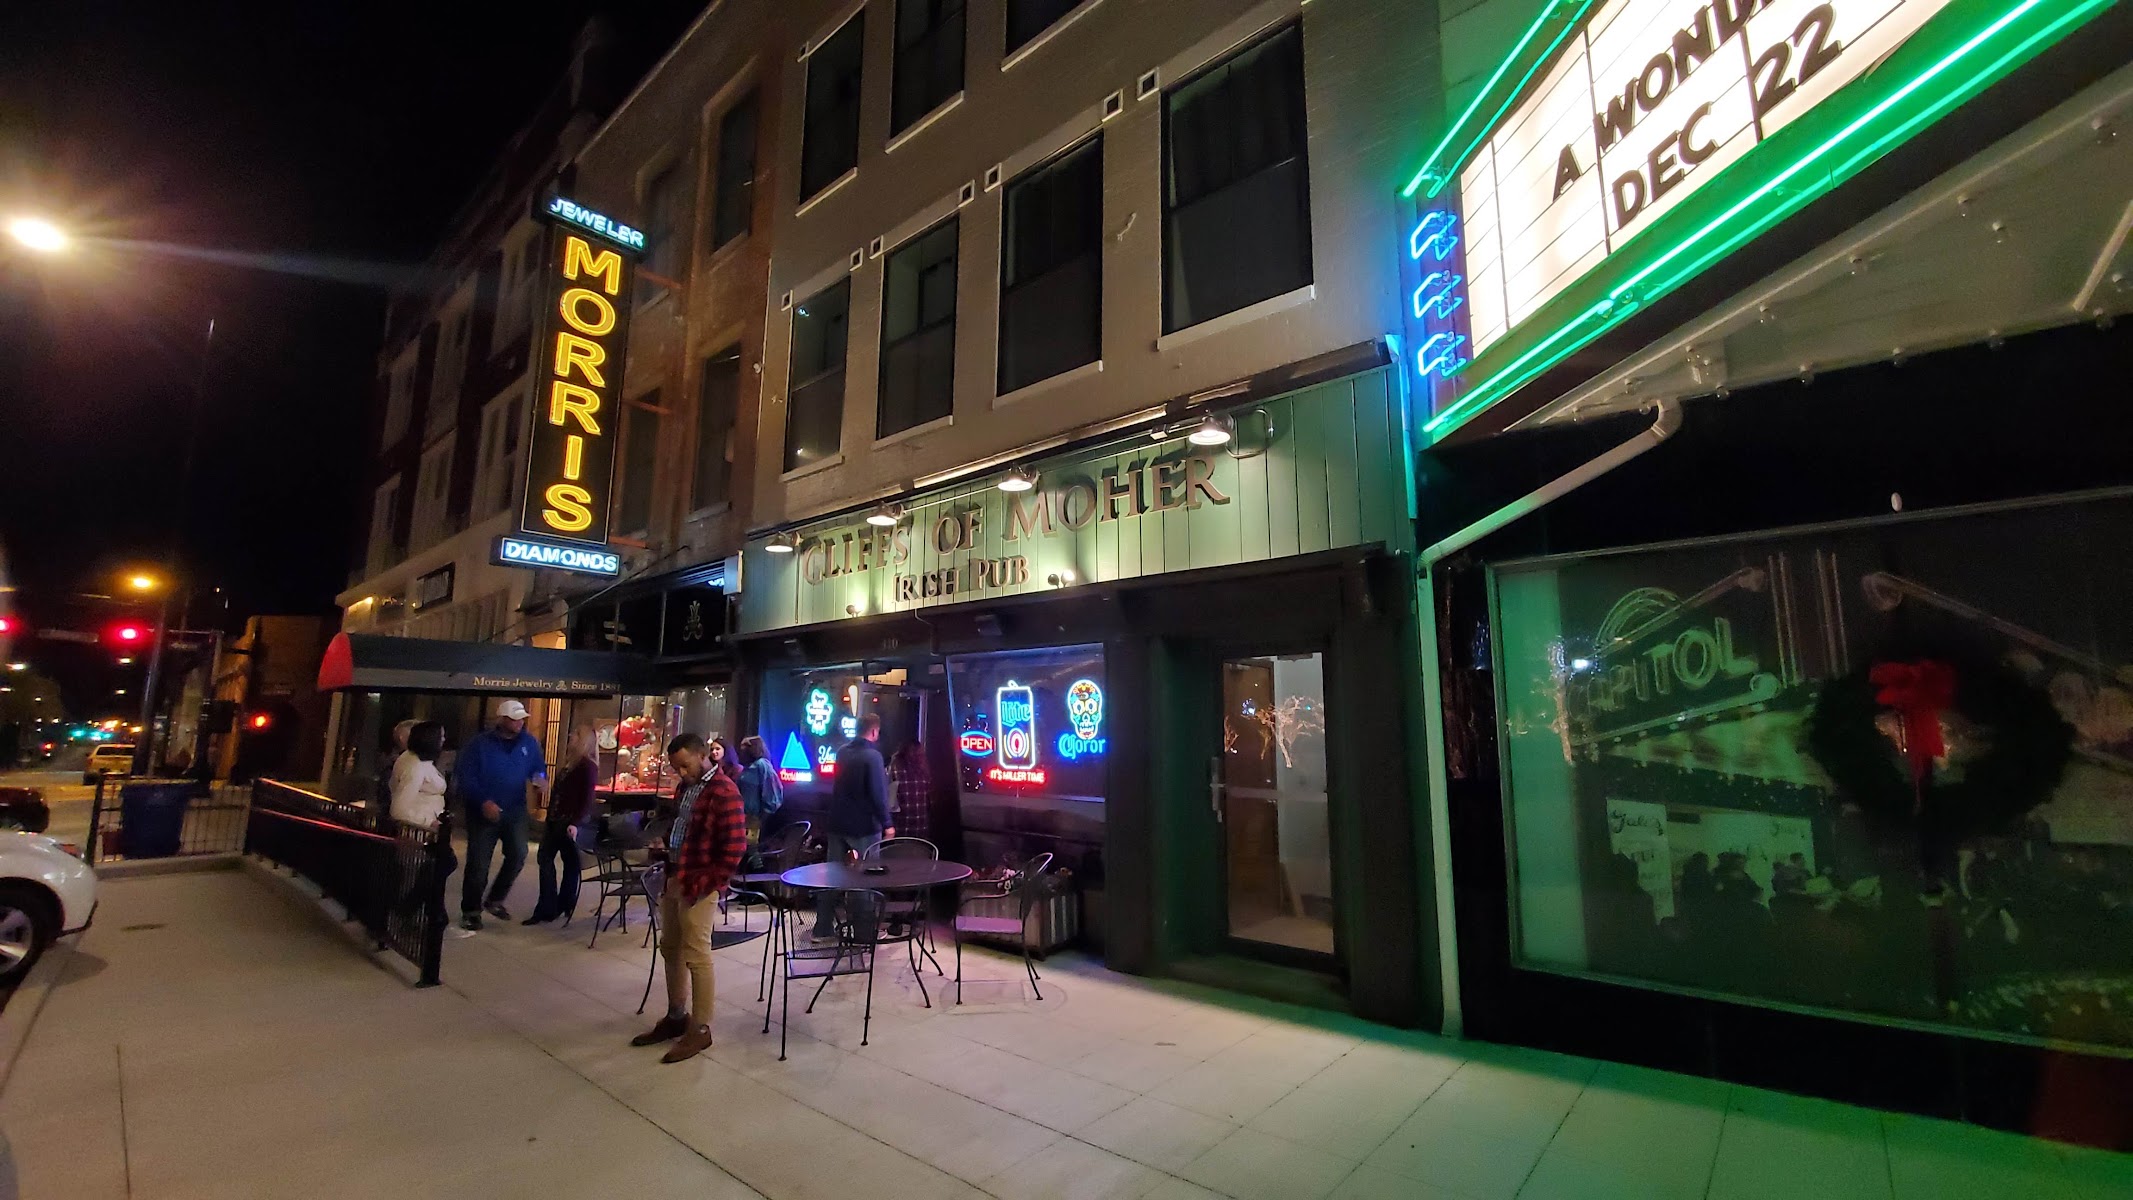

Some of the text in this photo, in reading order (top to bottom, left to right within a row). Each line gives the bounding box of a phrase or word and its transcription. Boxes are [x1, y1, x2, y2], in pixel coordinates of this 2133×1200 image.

[1552, 0, 1775, 203] A WOND
[1612, 3, 1843, 230] DEC 22
[550, 198, 644, 248] JEWELER
[542, 236, 622, 533] MORRIS
[802, 456, 1231, 586] CLIFFS OF MOHER
[505, 540, 617, 574] DIAMONDS
[894, 556, 1030, 602] IRISH PUB
[473, 676, 511, 688] Morris
[512, 678, 553, 690] Jewelry
[571, 681, 597, 690] Since
[1001, 701, 1031, 727] Lite
[961, 737, 993, 750] OPEN
[1027, 771, 1045, 783] TIME
